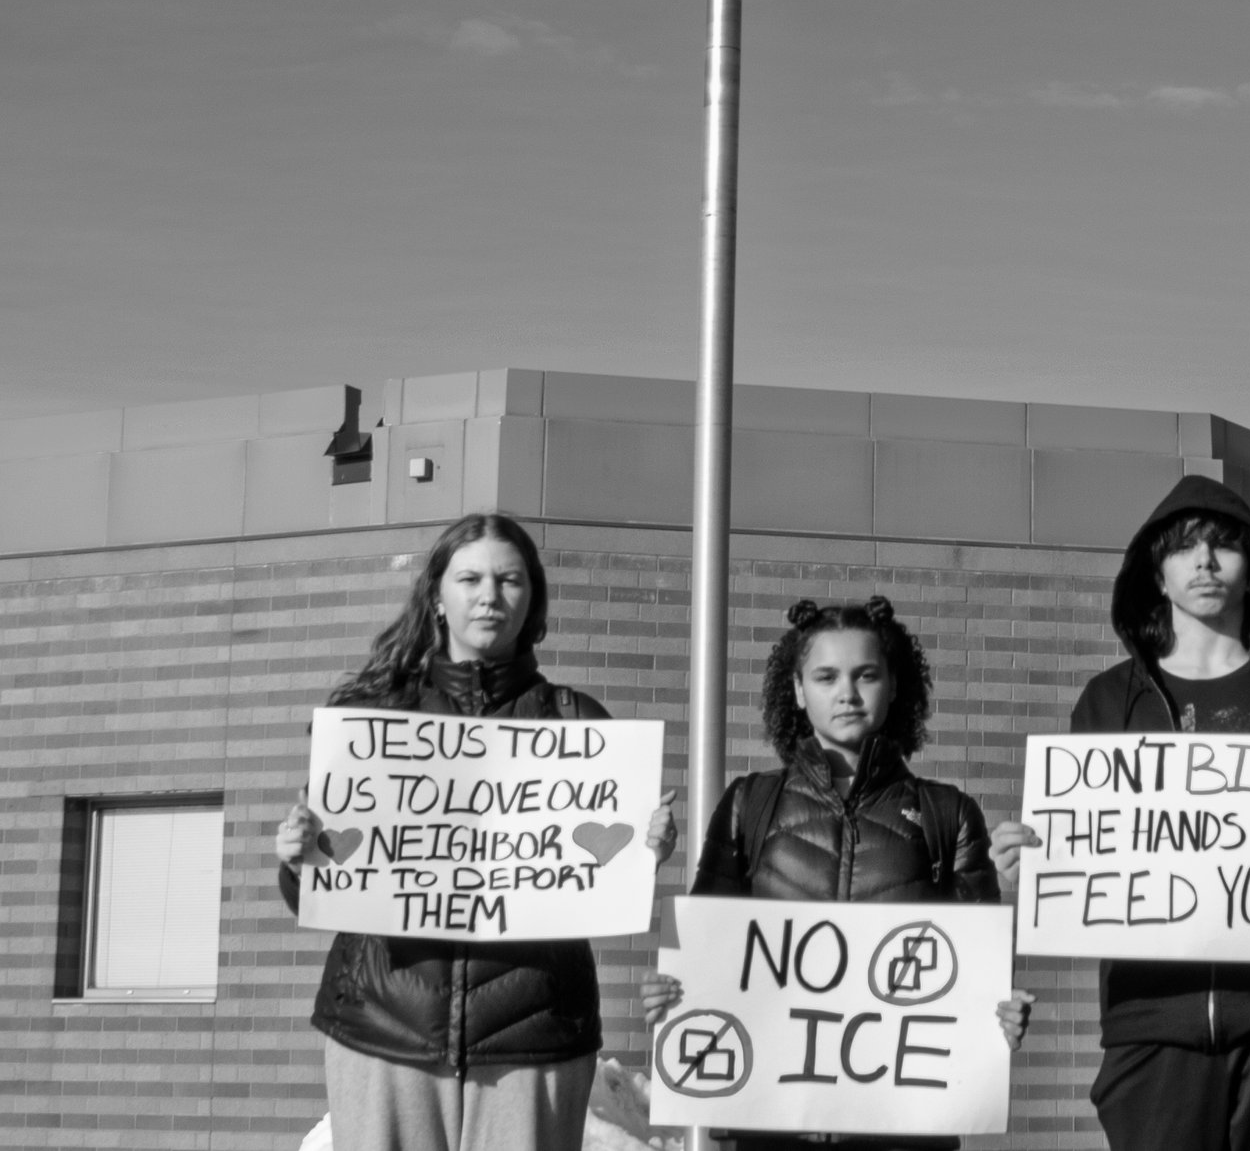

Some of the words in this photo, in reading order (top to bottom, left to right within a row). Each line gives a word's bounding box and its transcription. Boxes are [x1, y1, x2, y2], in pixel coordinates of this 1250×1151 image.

[342, 716, 487, 760] JESUS
[498, 725, 606, 759] TOLD
[1045, 736, 1176, 797] DON'T
[322, 772, 376, 814] US
[388, 774, 440, 815] TO
[443, 779, 542, 815] LOVE
[547, 779, 618, 812] OUR
[367, 824, 562, 865] NEIGHBOR
[1032, 809, 1121, 860] THE
[1131, 806, 1246, 855] HANDS
[312, 867, 379, 891] NOT
[391, 868, 437, 890] TO
[453, 863, 601, 891] DEPORT
[1033, 870, 1198, 928] FEED
[393, 893, 507, 935] THEM
[740, 918, 848, 994] NO
[777, 1007, 957, 1089] ICE
